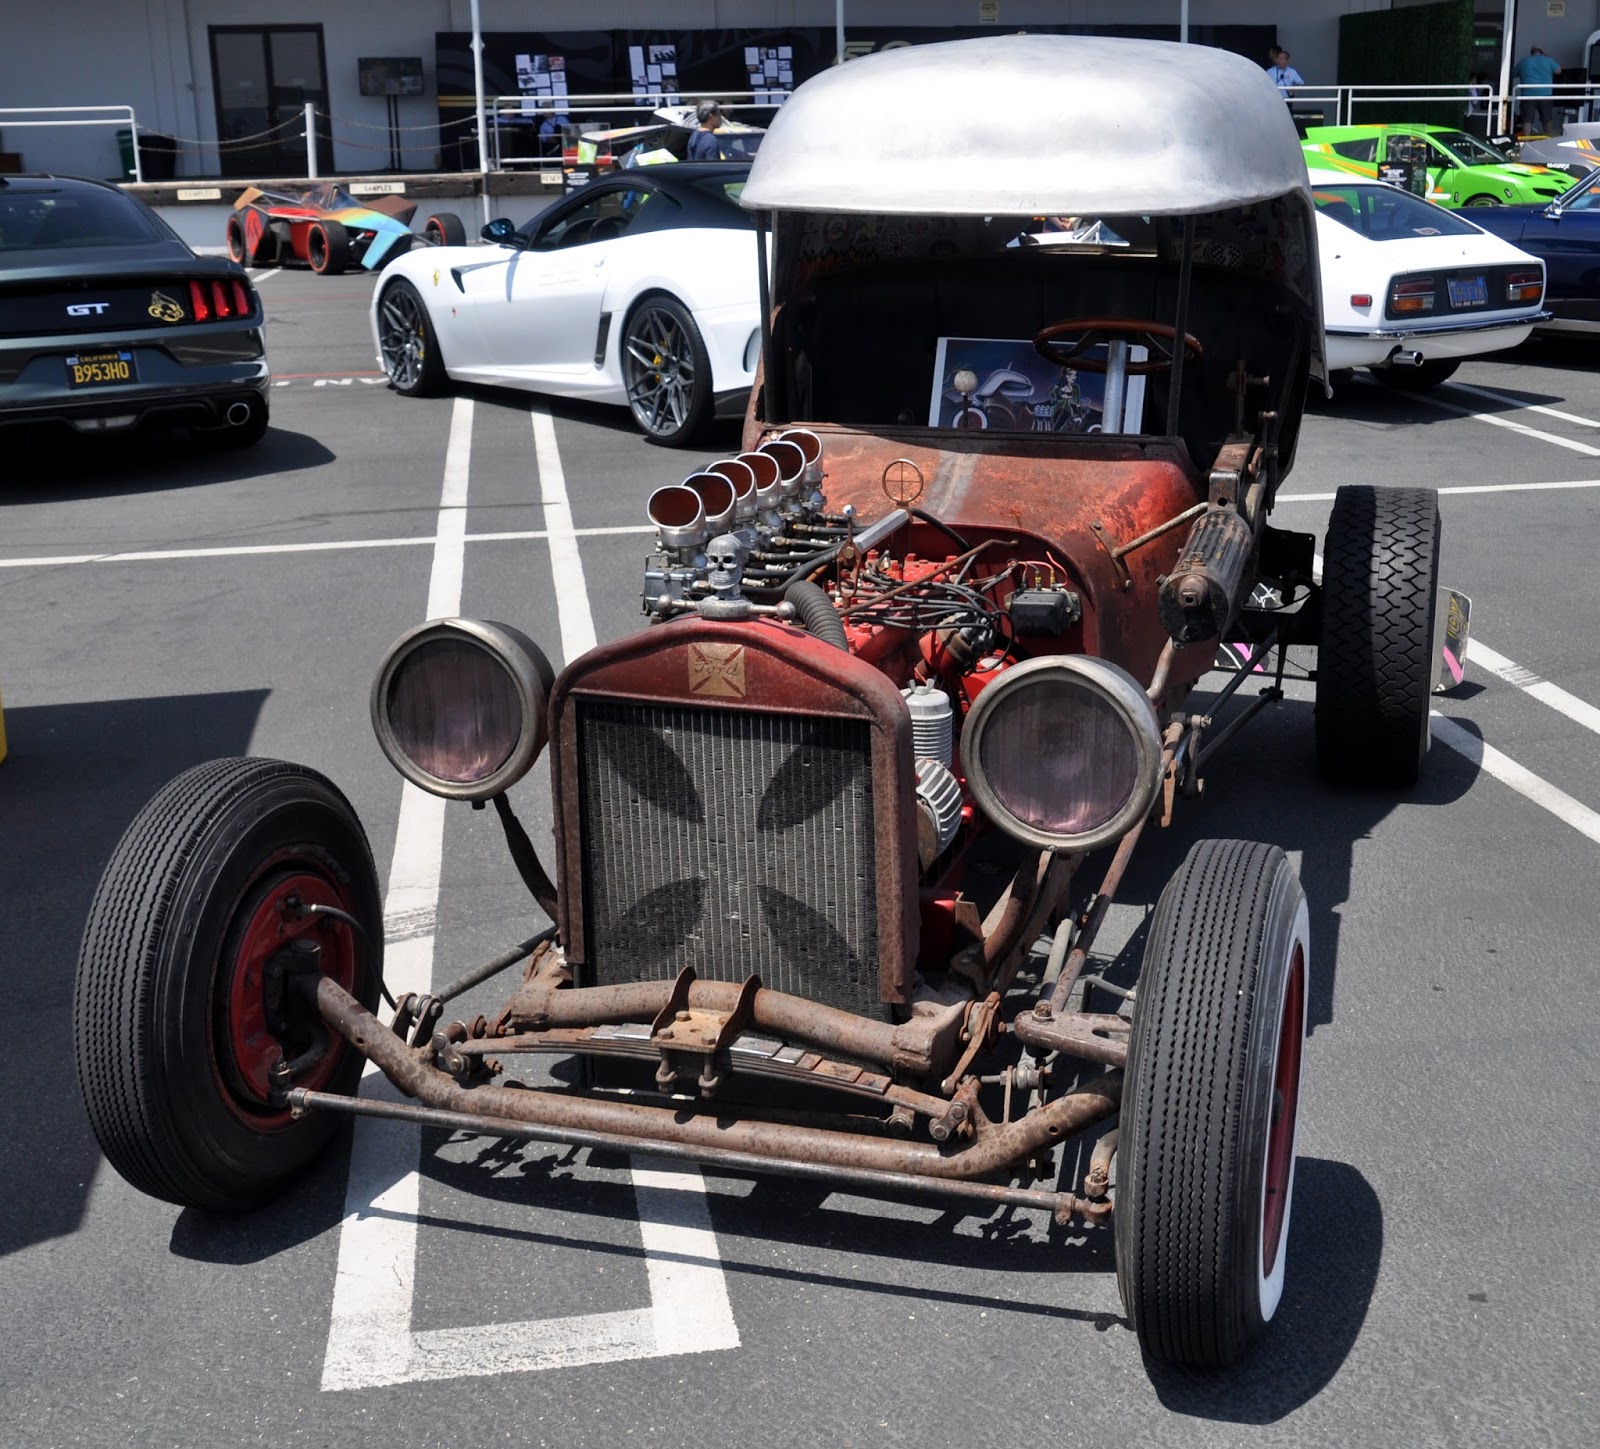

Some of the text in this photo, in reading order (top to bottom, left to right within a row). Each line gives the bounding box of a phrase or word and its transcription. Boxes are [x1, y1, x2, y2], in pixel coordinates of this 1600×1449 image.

[67, 303, 110, 316] GT
[80, 353, 118, 362] CALIFORNIA
[694, 656, 739, 676] Ford
